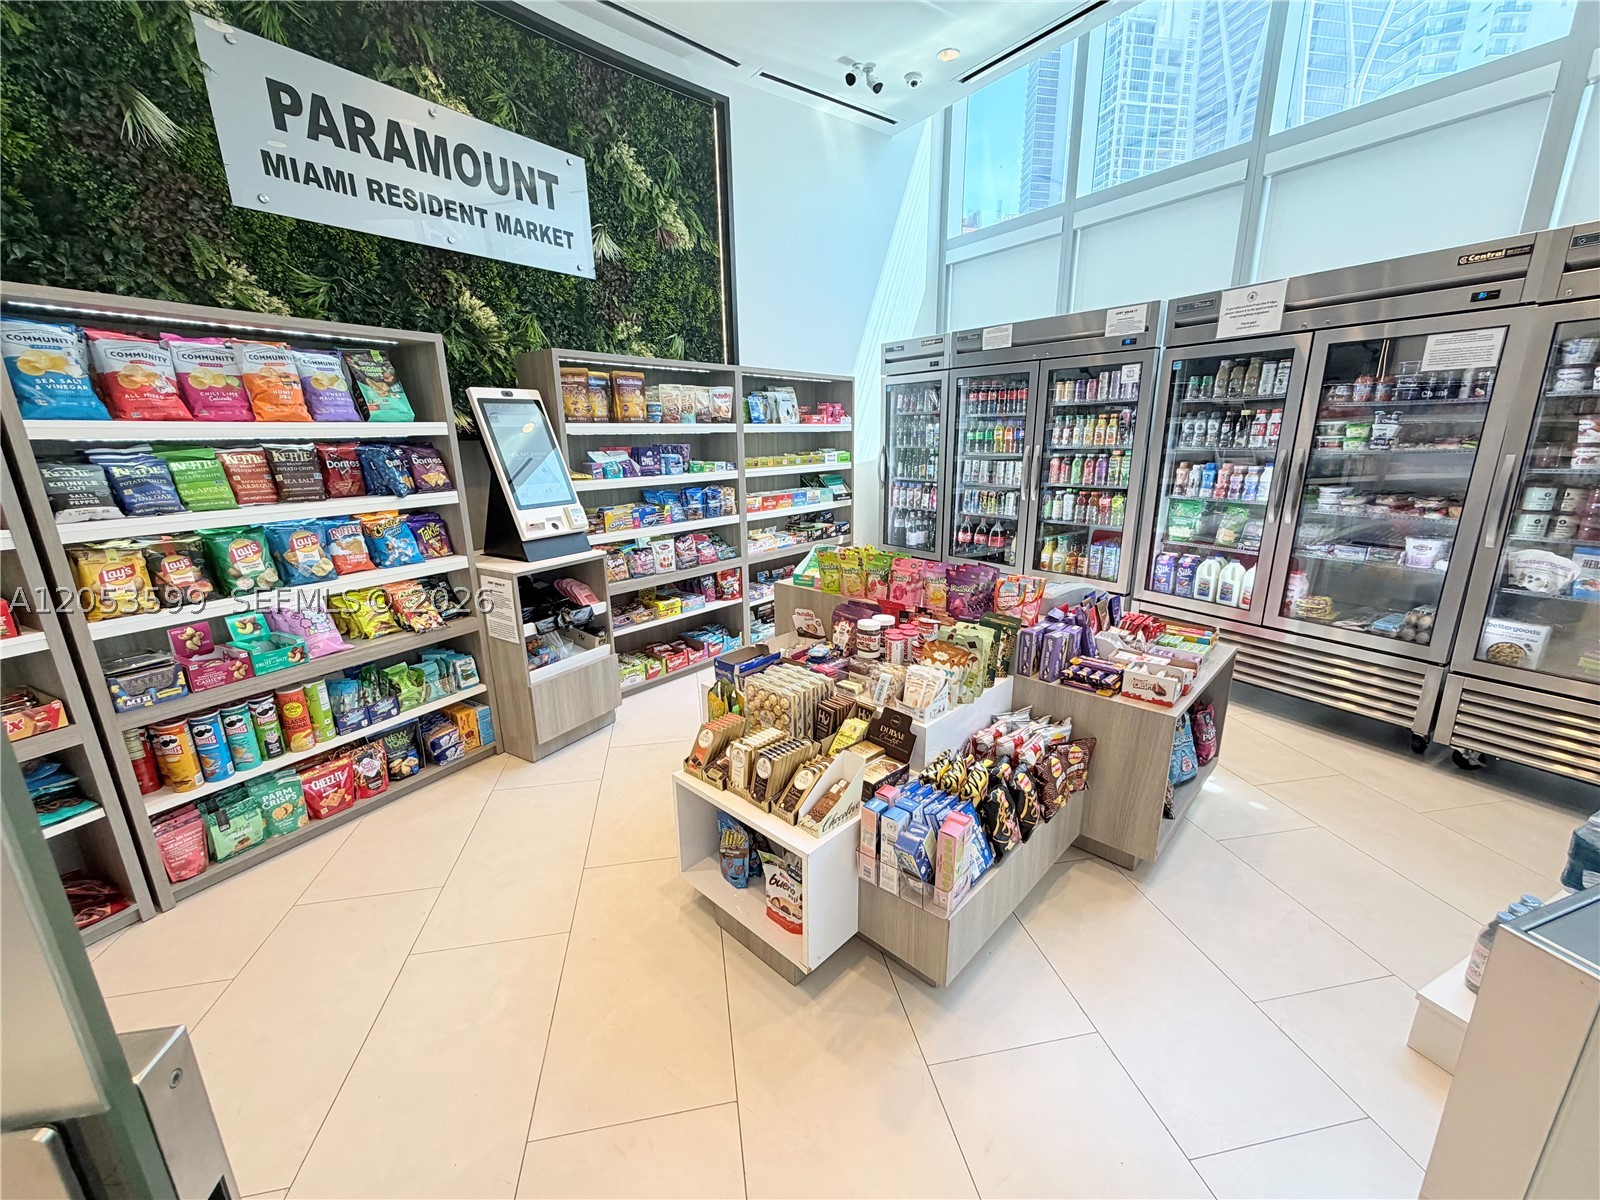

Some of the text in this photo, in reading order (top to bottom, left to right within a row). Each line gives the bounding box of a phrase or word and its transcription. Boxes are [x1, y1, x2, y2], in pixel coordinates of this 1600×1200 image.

[265, 76, 559, 211] PARAMOUNT
[260, 149, 574, 250] MIAMI RESIDENT MARKET
[1469, 249, 1506, 262] Central
[6, 333, 75, 345] COMMUNITY
[110, 351, 167, 364] COMMUNITY
[181, 353, 235, 362] COMMUNITY
[326, 459, 360, 469] Doritos
[412, 457, 443, 465] Doritos
[418, 523, 441, 543] Takis
[293, 534, 318, 550] Lay's
[232, 543, 259, 560] Lay's
[165, 557, 191, 573] Lay's
[1155, 565, 1170, 574] Silk
[1177, 567, 1192, 577] Silk
[1517, 558, 1572, 573] bettergoods
[102, 566, 133, 581] Lay's
[1487, 621, 1541, 636] bettergoods
[857, 635, 877, 643] nutella
[285, 716, 307, 725] CLASSIC
[384, 730, 408, 743] NEW
[880, 724, 905, 740] DUBAI
[389, 737, 410, 750] YORK
[311, 771, 344, 790] CHEEZ-IT
[261, 791, 298, 810] CRISPS
[262, 786, 293, 801] PARM
[822, 801, 860, 832] Chocolove
[769, 873, 796, 896] bueno
